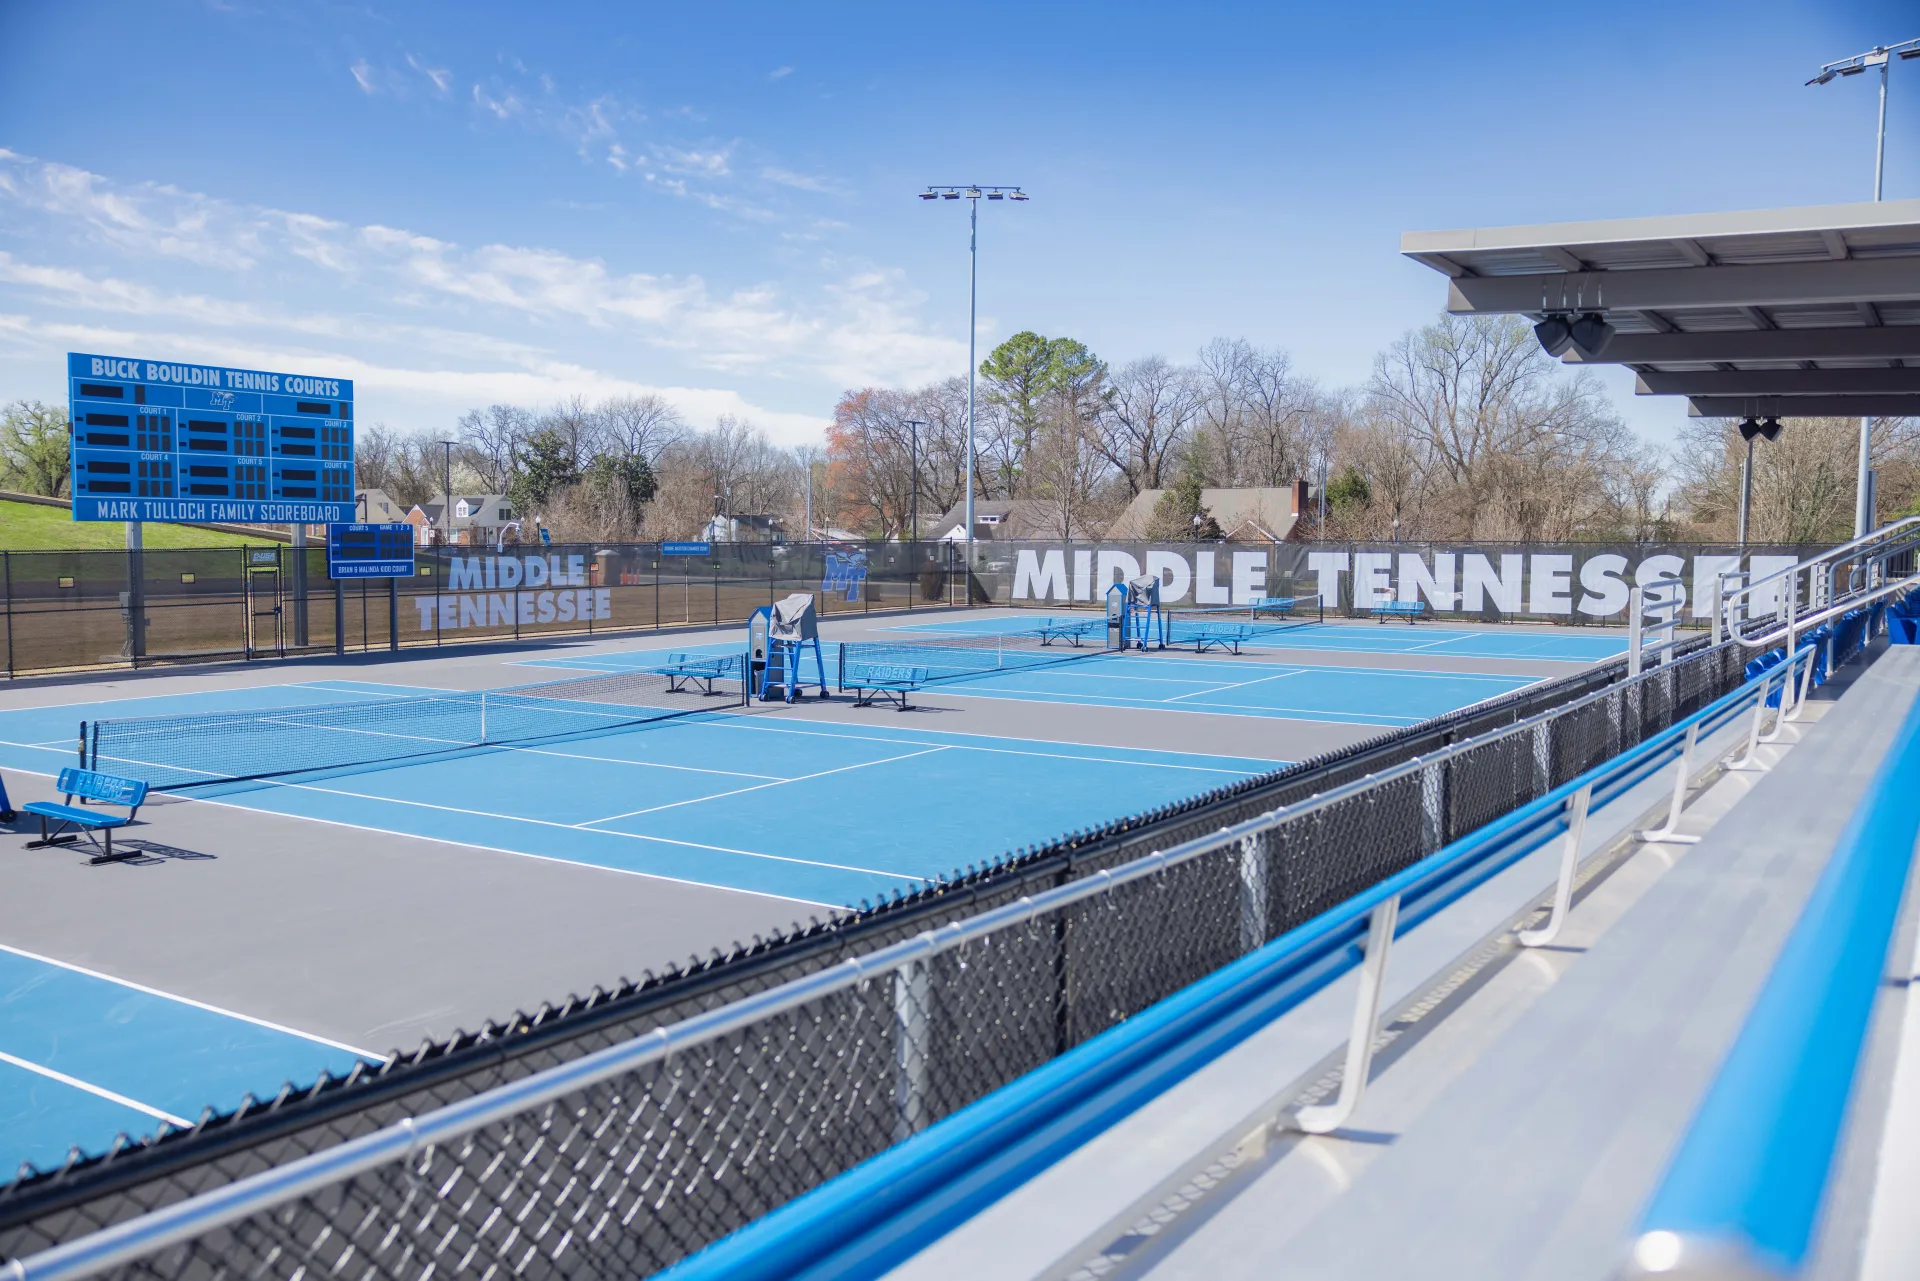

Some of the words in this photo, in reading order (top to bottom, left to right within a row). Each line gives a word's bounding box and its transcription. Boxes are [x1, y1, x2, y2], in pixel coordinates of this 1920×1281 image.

[91, 357, 140, 380] BUCK
[146, 363, 220, 388] BOULDIN
[225, 370, 280, 392] TENNIS
[284, 376, 340, 397] COURTS
[139, 406, 161, 415] COURT
[236, 413, 256, 421] COURT
[324, 420, 343, 428] COURT
[141, 453, 163, 461] COURT
[163, 453, 169, 461] 4
[237, 457, 257, 465] COURT
[258, 458, 263, 466] 5
[324, 461, 343, 469] COURT
[97, 500, 139, 519] MARK
[144, 502, 205, 520] TULLOCH
[211, 503, 255, 521] FAMILY
[260, 504, 340, 521] SCOREBOARD
[338, 566, 353, 574] BRIAN
[358, 565, 380, 573] MALINDA
[448, 554, 585, 590] MIDDLE
[821, 553, 867, 603] MT
[1011, 549, 1268, 605] MIDDLE
[1307, 551, 1799, 619] TENNESSEE
[414, 588, 611, 631] TENNESSEE
[1202, 624, 1241, 634] RAIDERS
[867, 665, 913, 680] RAIDERS
[74, 771, 126, 799] RAIDERS
